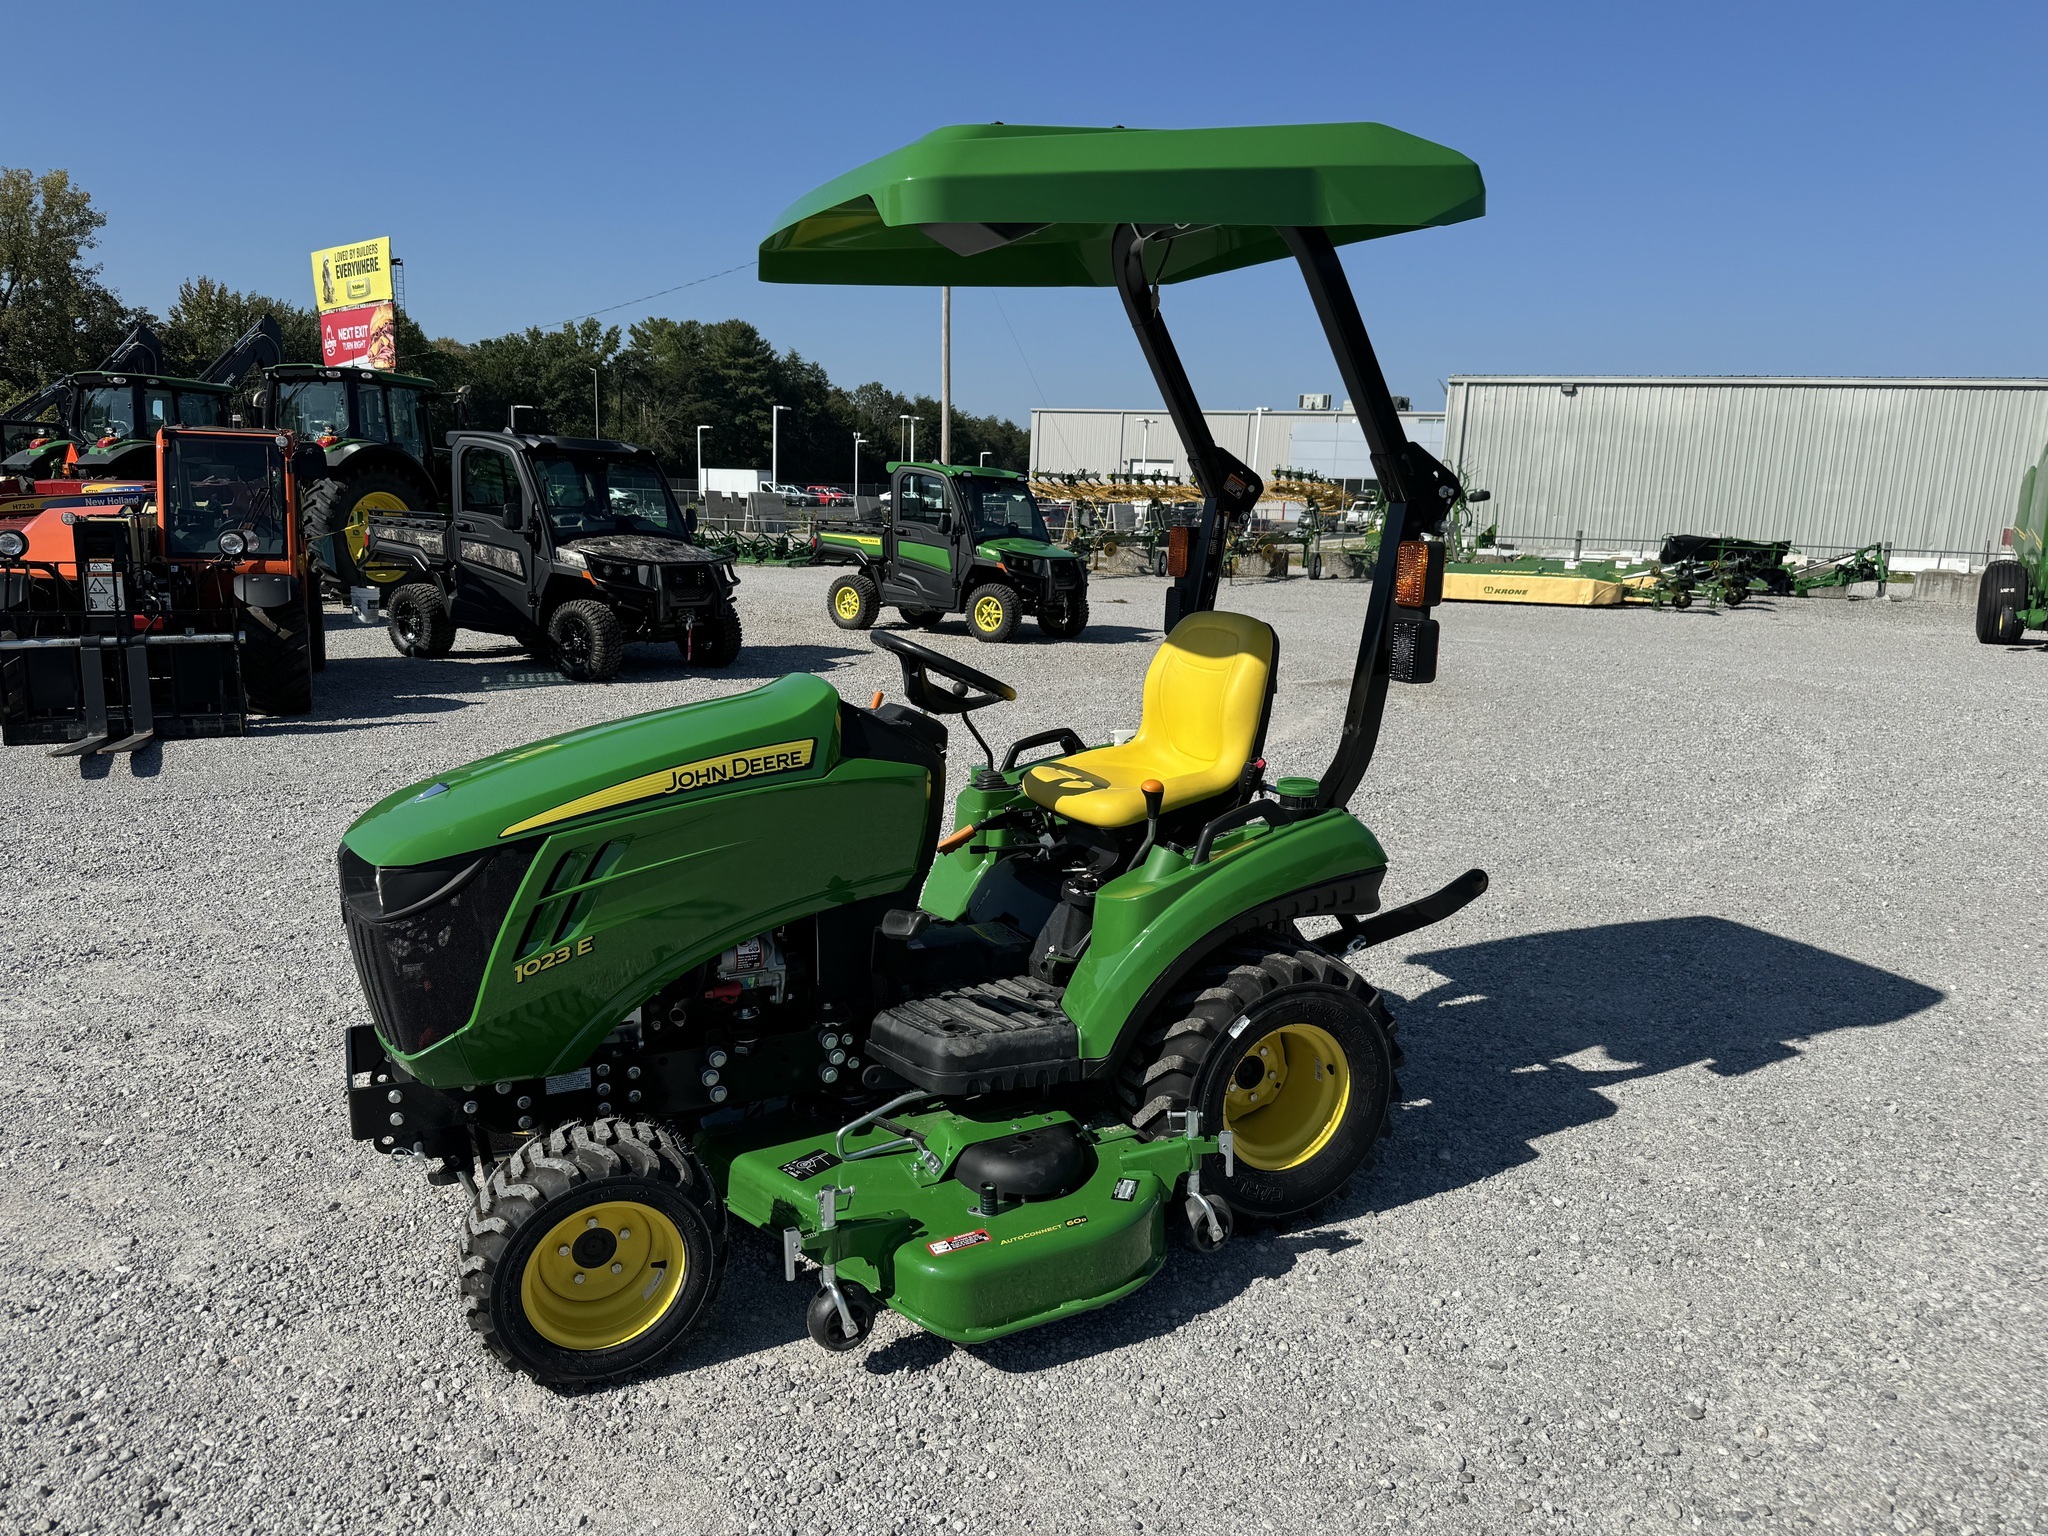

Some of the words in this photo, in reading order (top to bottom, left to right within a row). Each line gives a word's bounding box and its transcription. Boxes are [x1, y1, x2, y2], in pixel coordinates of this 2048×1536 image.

[334, 250, 348, 262] LOVED
[349, 248, 355, 259] BY
[357, 243, 378, 258] BUILDERS
[335, 257, 381, 279] EVERYWHERE.
[338, 327, 353, 340] NEXT
[354, 325, 368, 339] EXIT
[342, 341, 353, 350] TURN
[353, 340, 366, 349] RIGHT
[84, 498, 105, 506] New
[107, 496, 139, 504] Holland
[664, 764, 728, 791] JOHN
[732, 751, 803, 776] DEERE
[514, 946, 571, 983] 1023
[577, 935, 594, 956] E
